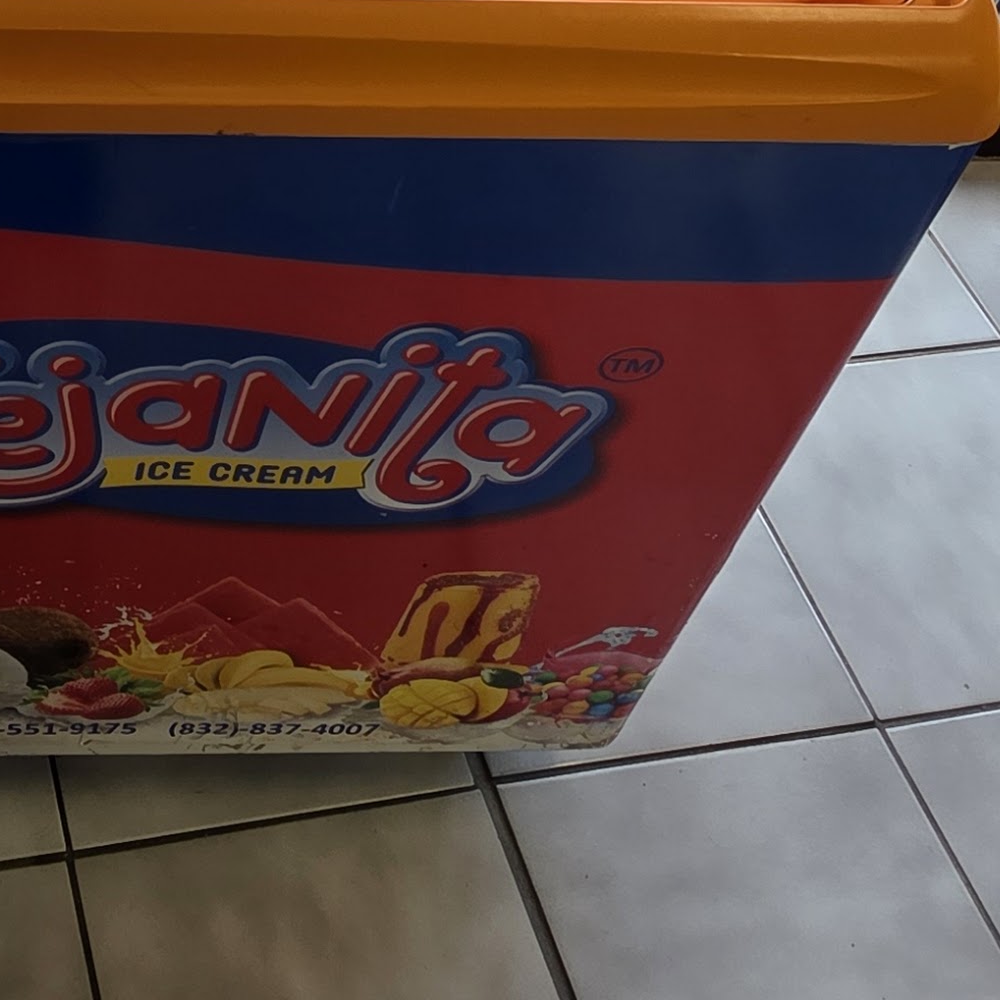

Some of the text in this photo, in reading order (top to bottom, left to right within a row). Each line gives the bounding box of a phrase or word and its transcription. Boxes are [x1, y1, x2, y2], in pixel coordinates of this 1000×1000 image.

[134, 459, 337, 487] ICE CREAM
[168, 720, 380, 740] (832)-837-4007
